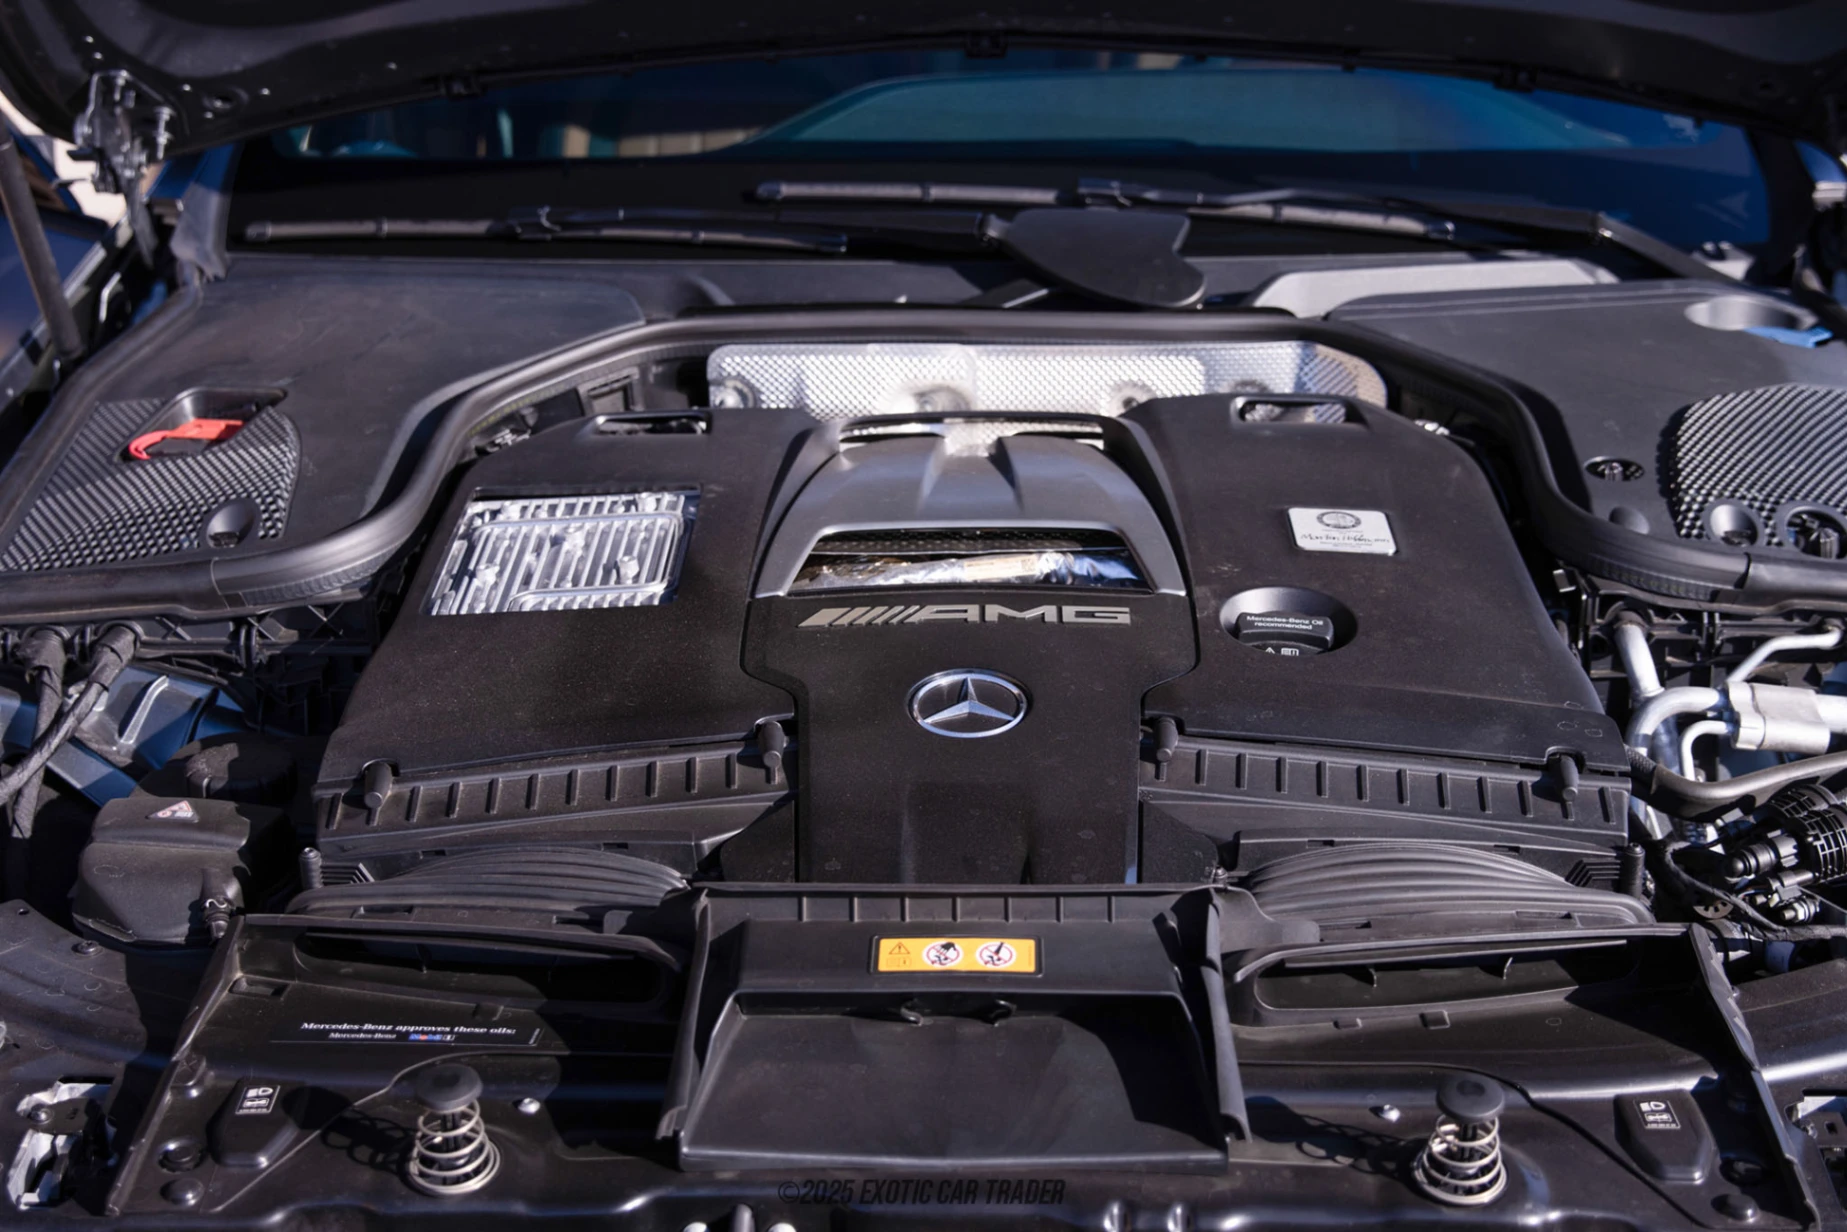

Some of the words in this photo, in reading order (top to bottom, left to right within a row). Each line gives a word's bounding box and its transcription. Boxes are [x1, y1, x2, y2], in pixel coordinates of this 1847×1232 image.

[903, 604, 1131, 625] AMG
[1246, 615, 1310, 624] Mercedes-Benz
[1254, 621, 1313, 630] recommended
[301, 1022, 393, 1031] Mercedes-Benz
[395, 1025, 451, 1033] approves
